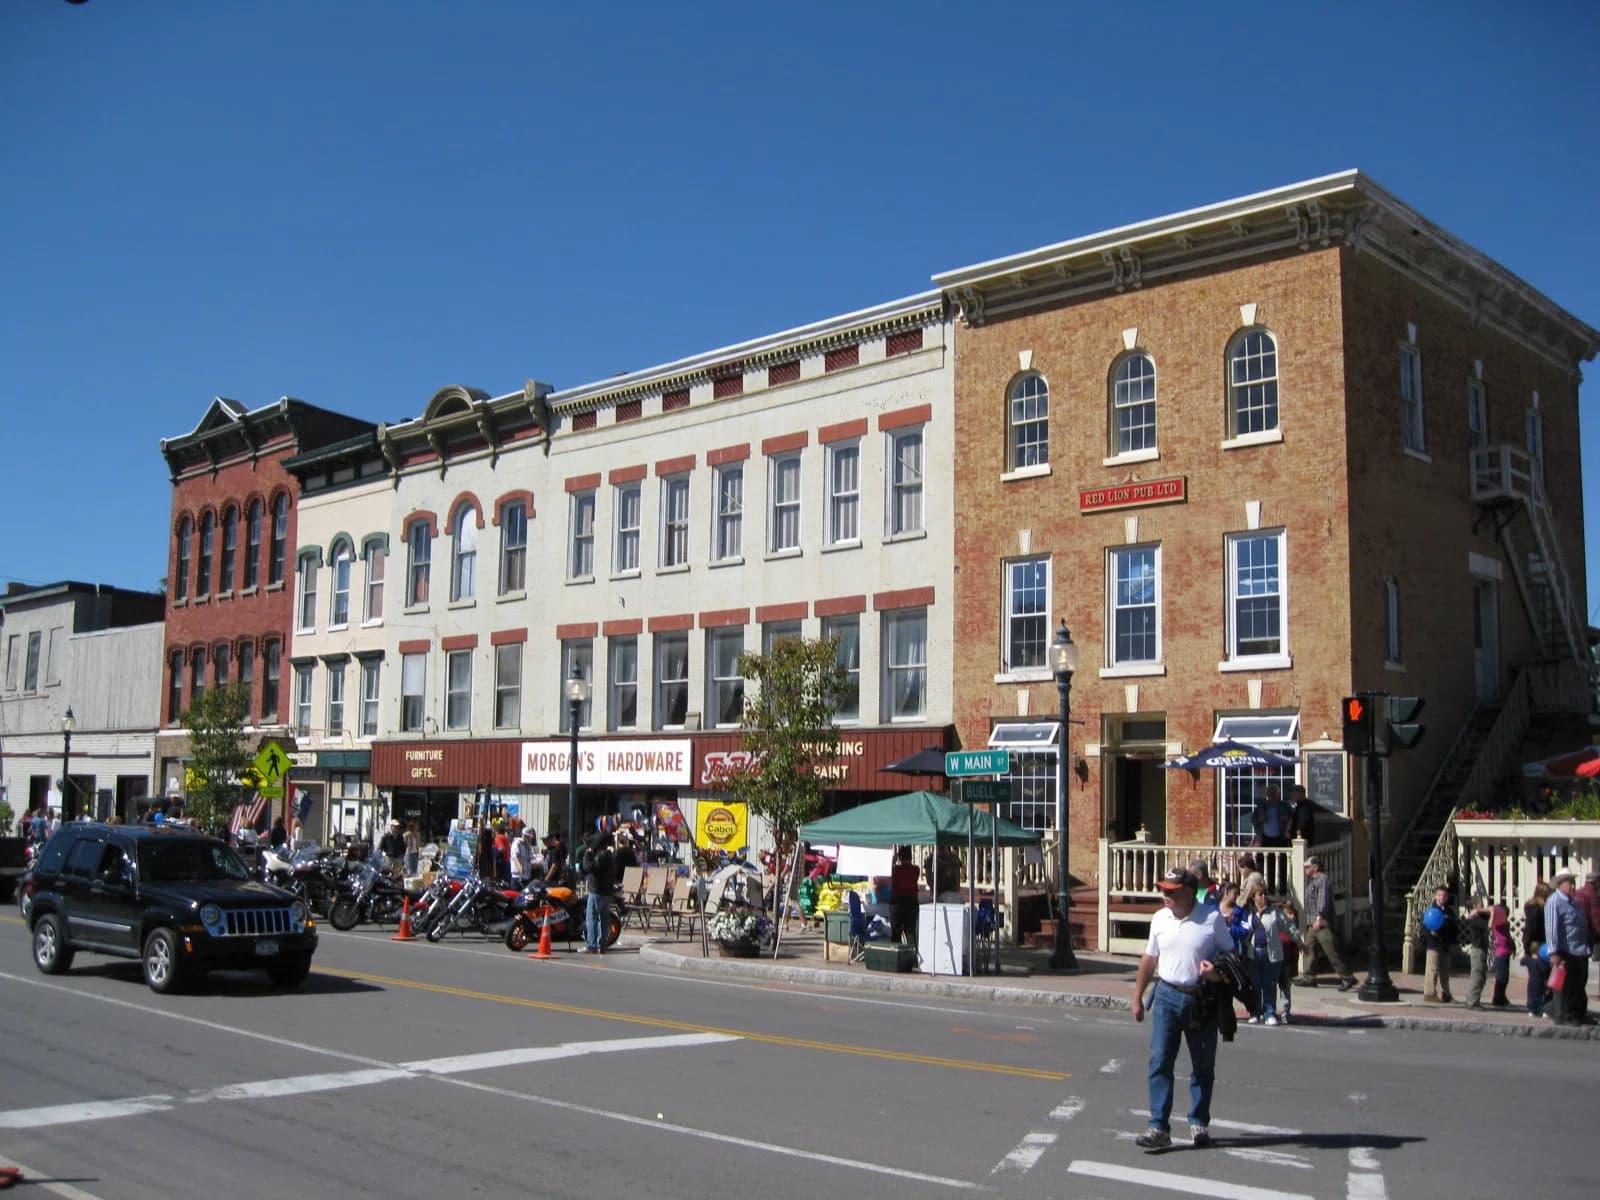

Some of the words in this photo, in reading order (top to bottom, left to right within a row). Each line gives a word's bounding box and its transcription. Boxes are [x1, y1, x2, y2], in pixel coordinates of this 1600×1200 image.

[1085, 493, 1105, 505] RED
[1108, 489, 1130, 502] LION
[1133, 486, 1154, 498] PUB
[1157, 483, 1177, 495] LTD
[405, 750, 443, 761] FURNITURE
[607, 751, 683, 772] HARDWARE
[1205, 755, 1267, 767] Corona
[950, 757, 959, 771] W
[964, 755, 992, 770] MAIN
[813, 765, 849, 779] PAINT
[966, 784, 995, 799] BUELL
[707, 824, 733, 833] Cabot
